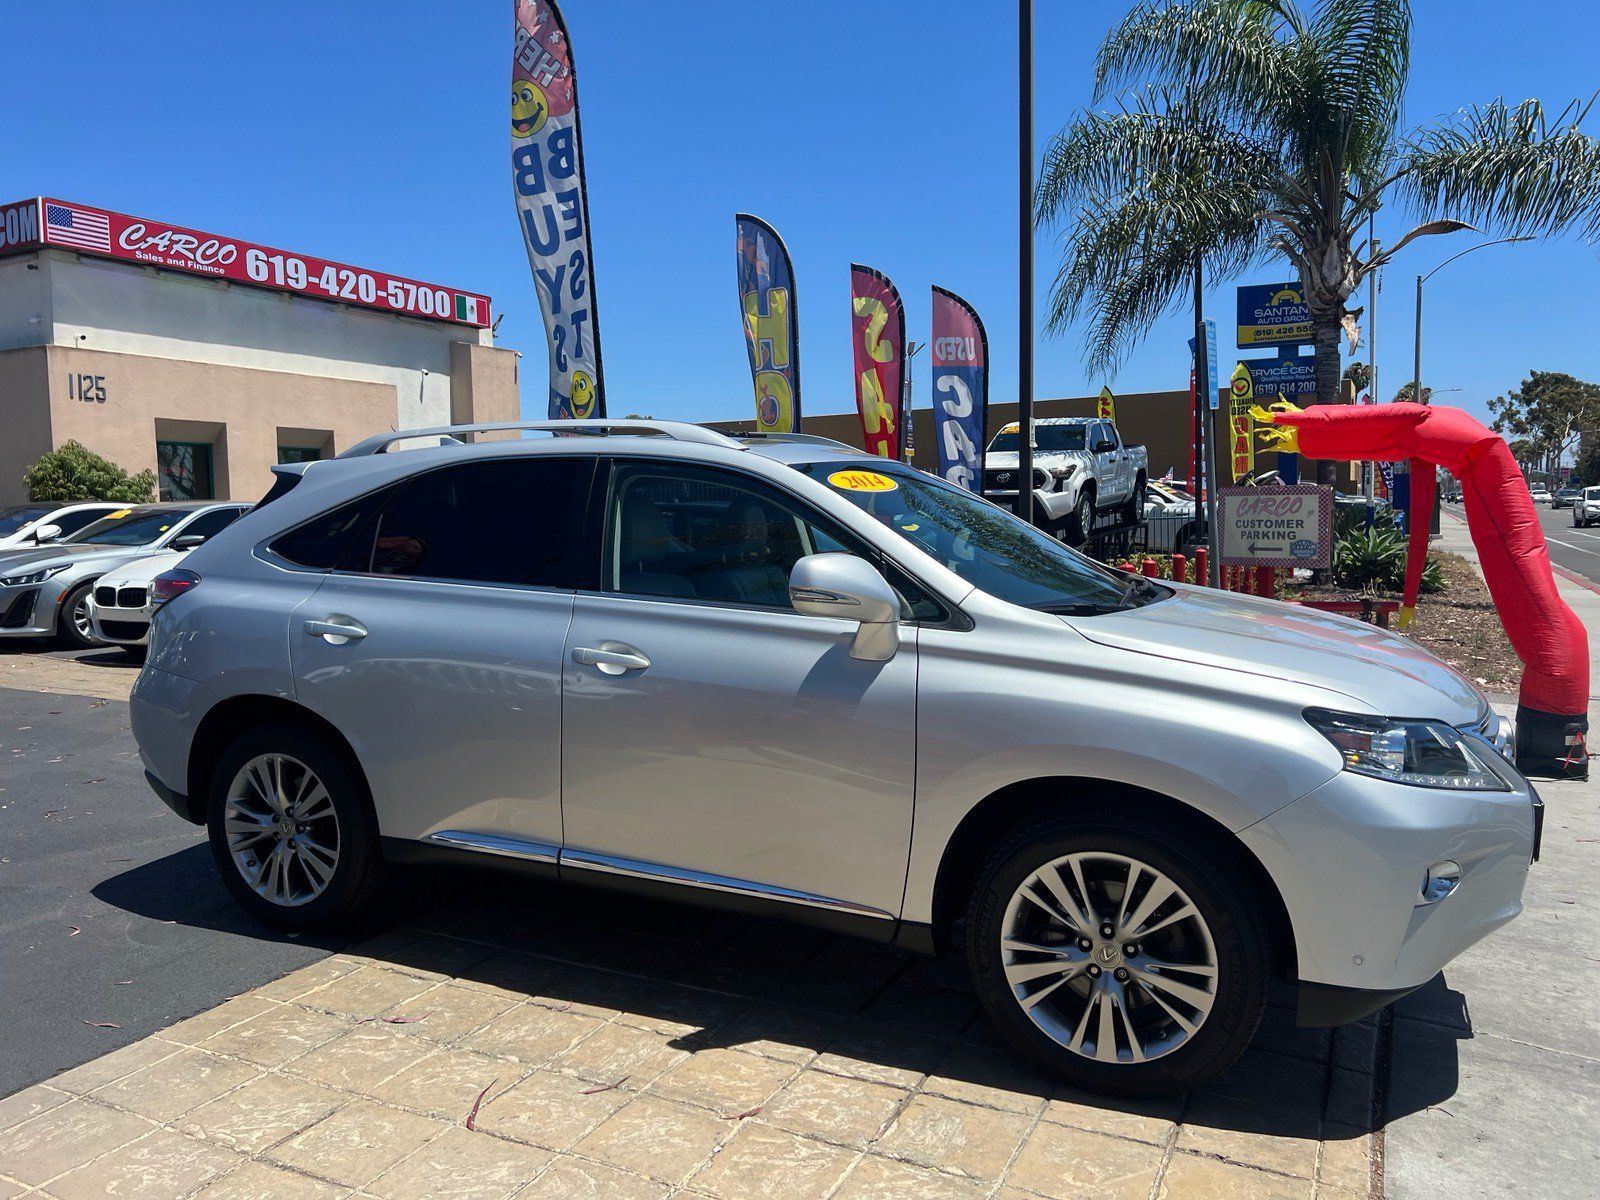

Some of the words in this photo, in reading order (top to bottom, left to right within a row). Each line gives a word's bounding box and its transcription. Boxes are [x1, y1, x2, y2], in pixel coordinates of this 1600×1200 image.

[118, 223, 238, 265] CARCO
[135, 250, 164, 264] Sales
[166, 257, 186, 268] and
[187, 261, 226, 275] Finance
[246, 248, 451, 318] 619-420-5700
[1254, 306, 1309, 318] SANTAN
[1257, 317, 1282, 325] AUTO
[1283, 315, 1310, 323] GROU
[1253, 328, 1275, 337] (619)
[1275, 327, 1294, 335] 426
[1251, 367, 1288, 377] ERVICE
[1289, 366, 1314, 374] CEN
[69, 372, 107, 404] 1125
[1255, 383, 1278, 395] (619)
[1280, 382, 1295, 394] 614
[1297, 381, 1316, 392] 200
[841, 475, 886, 489] 2014
[1235, 496, 1303, 518] CARCO
[1235, 519, 1304, 529] CUSTOMER
[1240, 530, 1297, 540] PARKING
